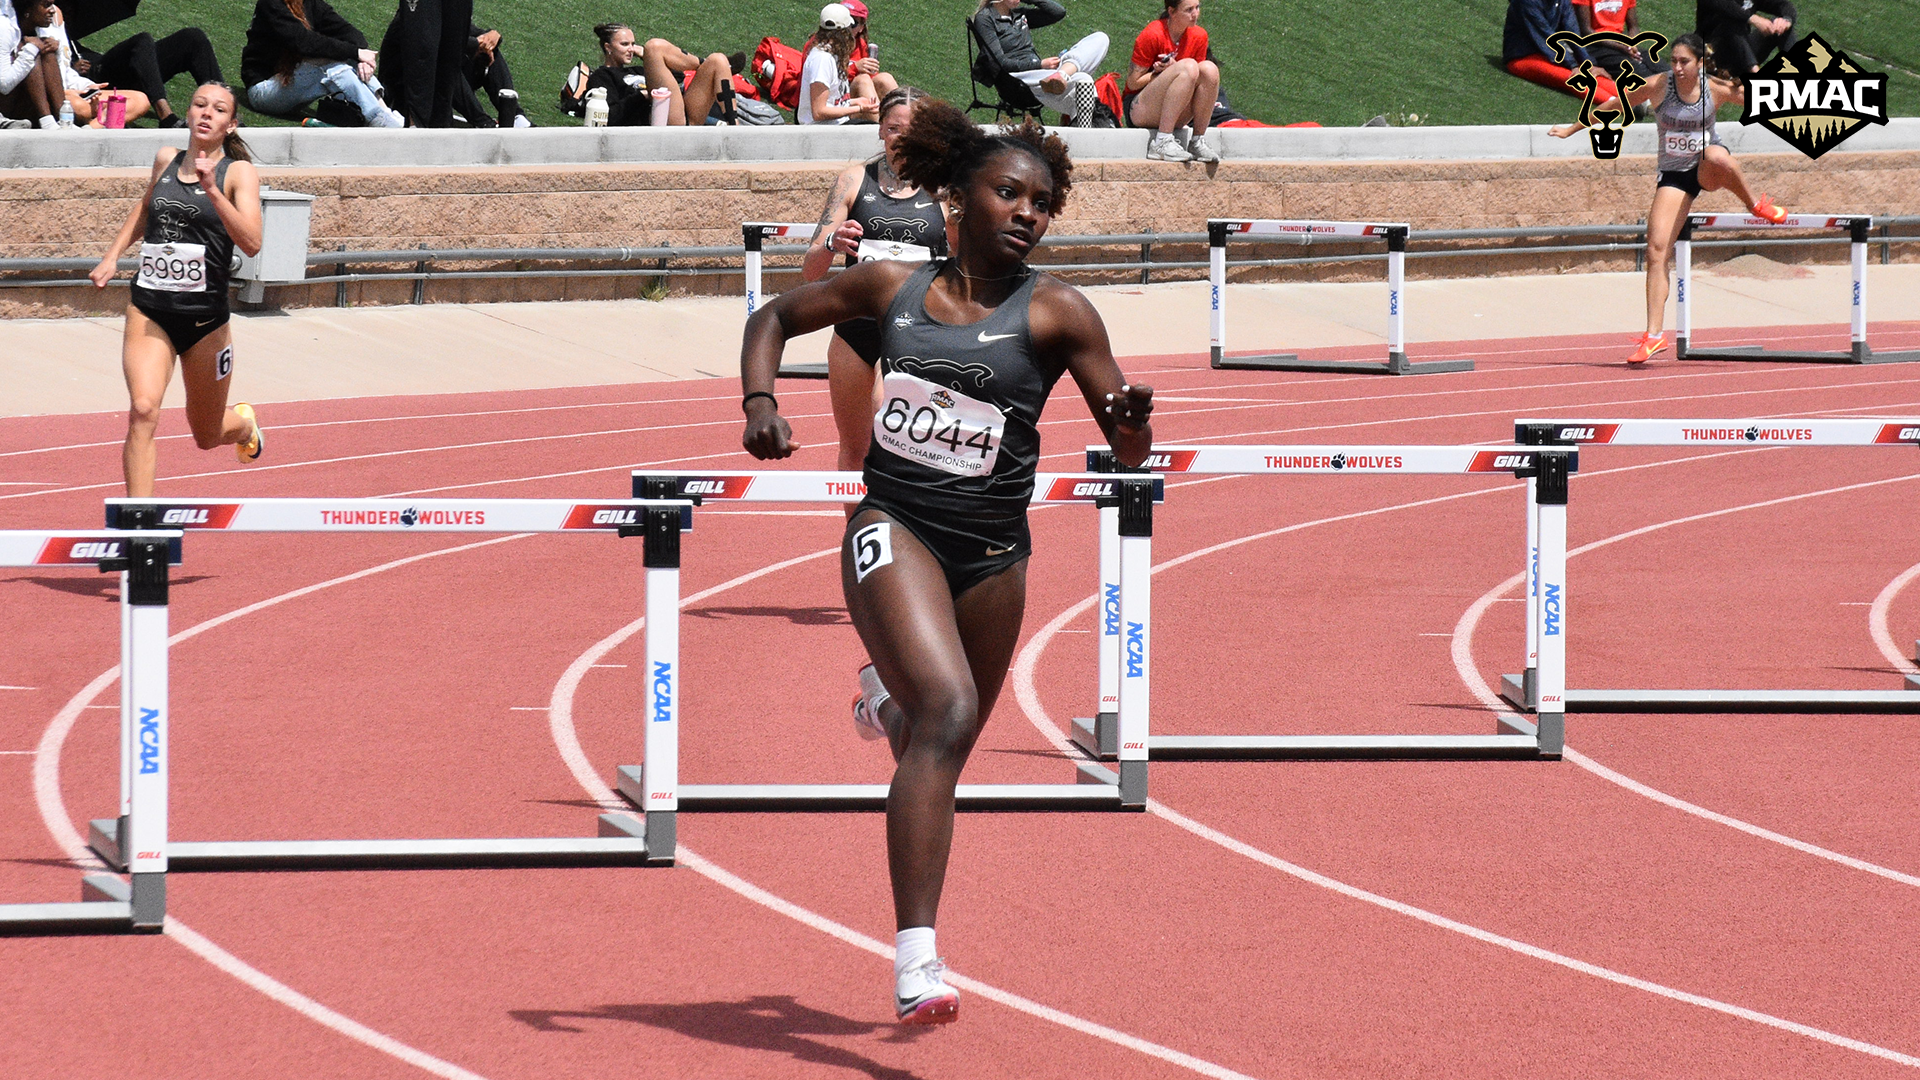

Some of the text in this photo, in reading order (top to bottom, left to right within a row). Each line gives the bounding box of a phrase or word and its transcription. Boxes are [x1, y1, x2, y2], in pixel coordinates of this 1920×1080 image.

[762, 226, 778, 234] GILL
[1311, 226, 1336, 234] WOLVES
[142, 255, 202, 281] 5998
[1852, 280, 1860, 306] NCAA
[219, 348, 231, 376] 6
[930, 392, 955, 407] RMAC
[882, 397, 994, 459] 6044
[1559, 427, 1595, 440] GILL
[1682, 429, 1812, 441] THUNDER WOLVES
[882, 435, 907, 451] RMAC
[909, 446, 982, 472] CHAMPIONSHIP
[1264, 456, 1403, 468] THUNDER WOLVES
[1493, 455, 1531, 468] GILL
[684, 481, 726, 494] GILL
[1073, 483, 1113, 496] GILL
[162, 509, 210, 524] GILL
[321, 511, 486, 525] THUNDER WOLVES
[593, 509, 637, 524] GILL
[69, 542, 121, 558] GILL
[857, 527, 882, 574] 5
[1105, 582, 1120, 636] NCAA
[1544, 582, 1560, 636] NCAA
[1127, 621, 1143, 678] NCAA
[654, 660, 671, 722] NCAA
[139, 706, 159, 775] NCAA
[651, 792, 673, 800] GILL
[136, 851, 161, 859] GILL
